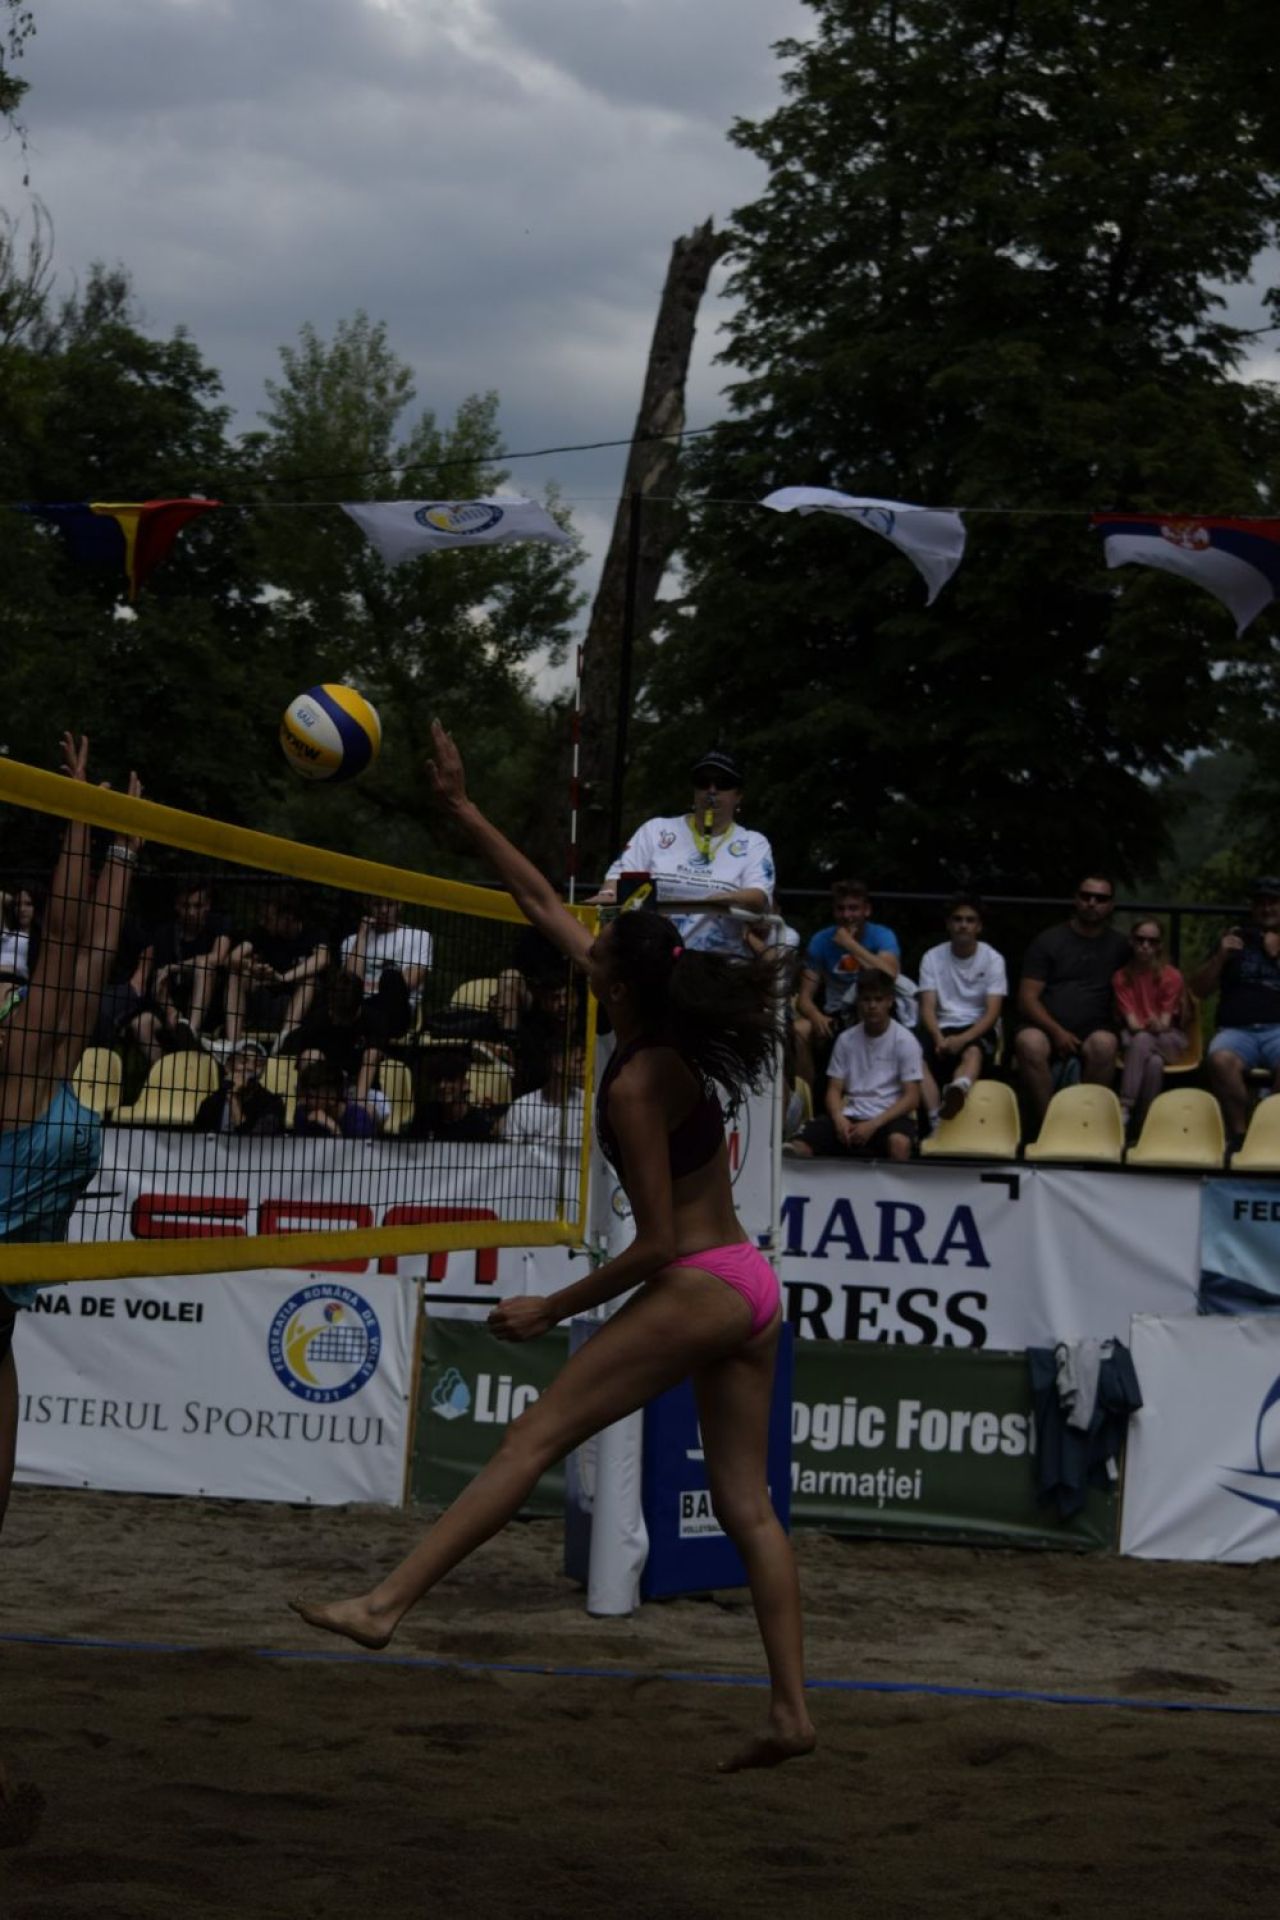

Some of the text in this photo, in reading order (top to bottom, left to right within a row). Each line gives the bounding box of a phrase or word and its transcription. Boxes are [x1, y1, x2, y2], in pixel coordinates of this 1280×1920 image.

[81, 1297, 115, 1317] DE
[125, 1299, 204, 1322] VOLEI
[783, 1281, 988, 1350] RESS
